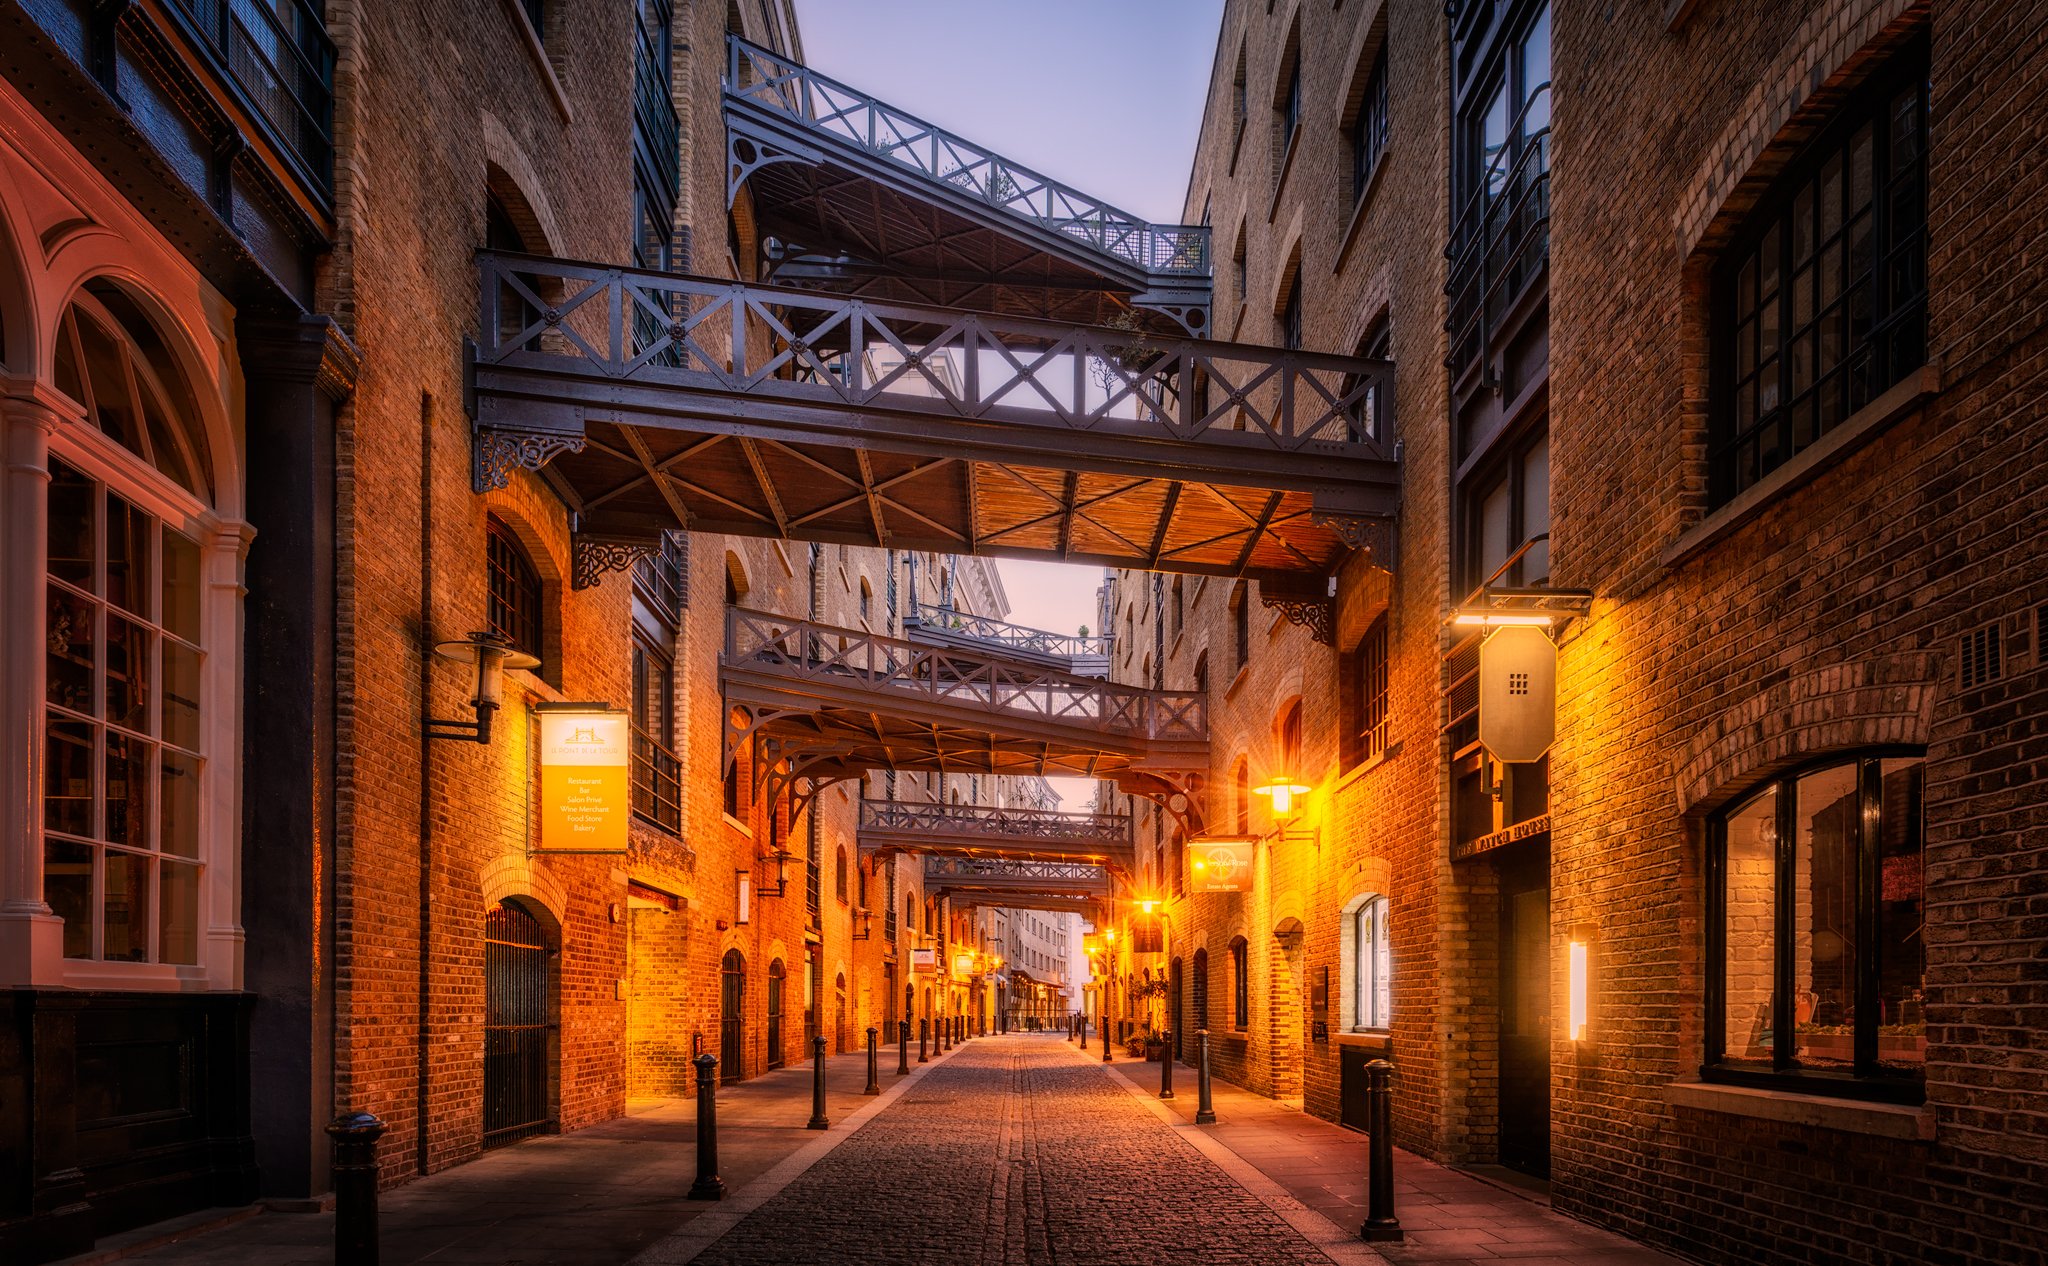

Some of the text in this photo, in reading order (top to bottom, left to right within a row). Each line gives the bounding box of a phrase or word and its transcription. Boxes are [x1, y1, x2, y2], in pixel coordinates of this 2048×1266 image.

[567, 777, 602, 785] Restaurant
[560, 805, 609, 813] Wine Merchant
[574, 824, 595, 832] Bakery
